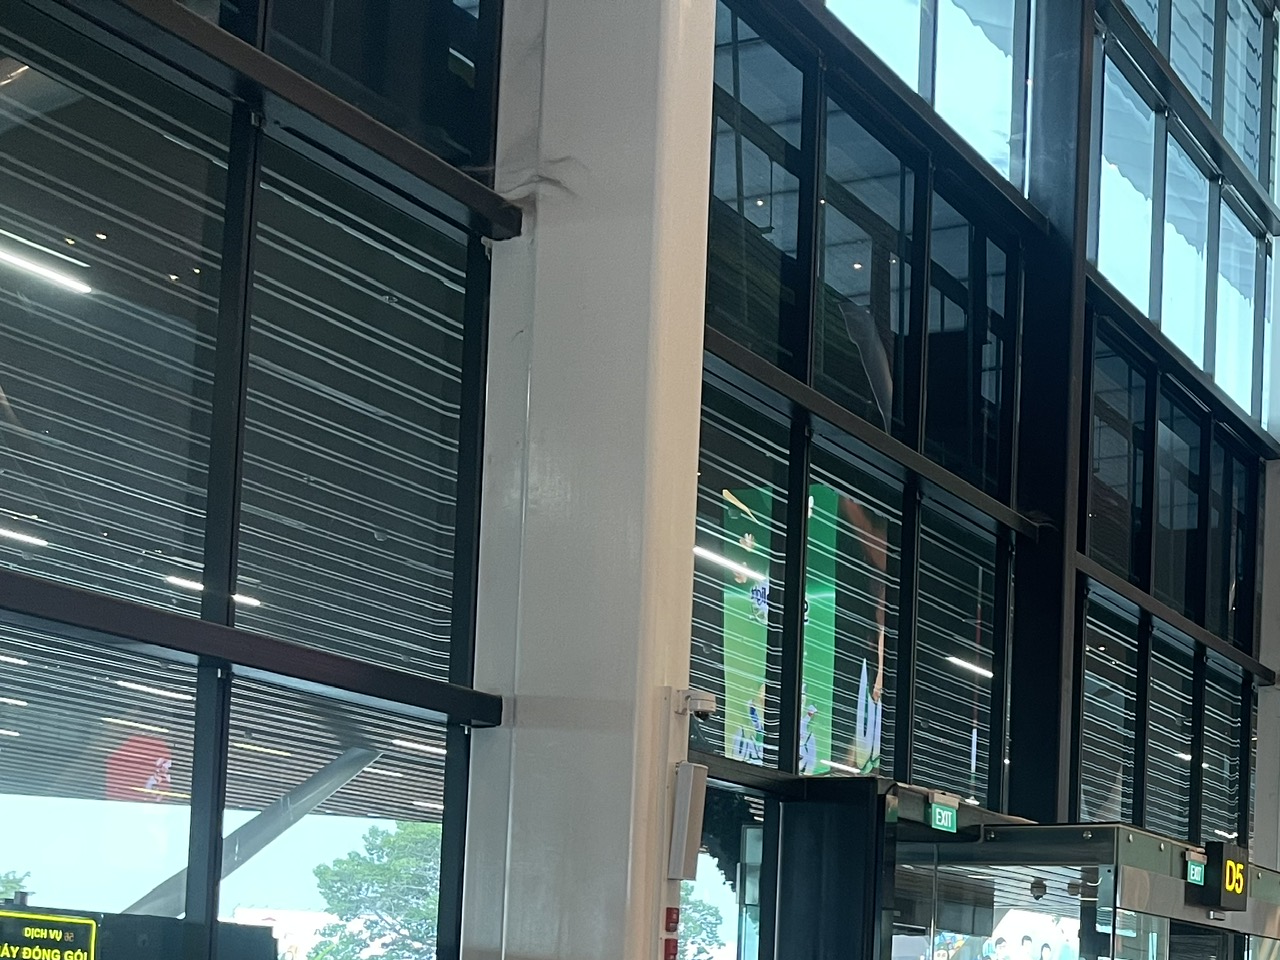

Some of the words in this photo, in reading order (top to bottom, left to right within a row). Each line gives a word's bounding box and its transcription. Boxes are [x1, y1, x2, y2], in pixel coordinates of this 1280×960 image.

[936, 807, 952, 828] EXIT
[1190, 865, 1202, 882] EXIT
[1225, 859, 1244, 894] D5
[24, 926, 48, 939] DỊCH
[49, 929, 63, 941] VỤ
[0, 942, 20, 959] ÁY
